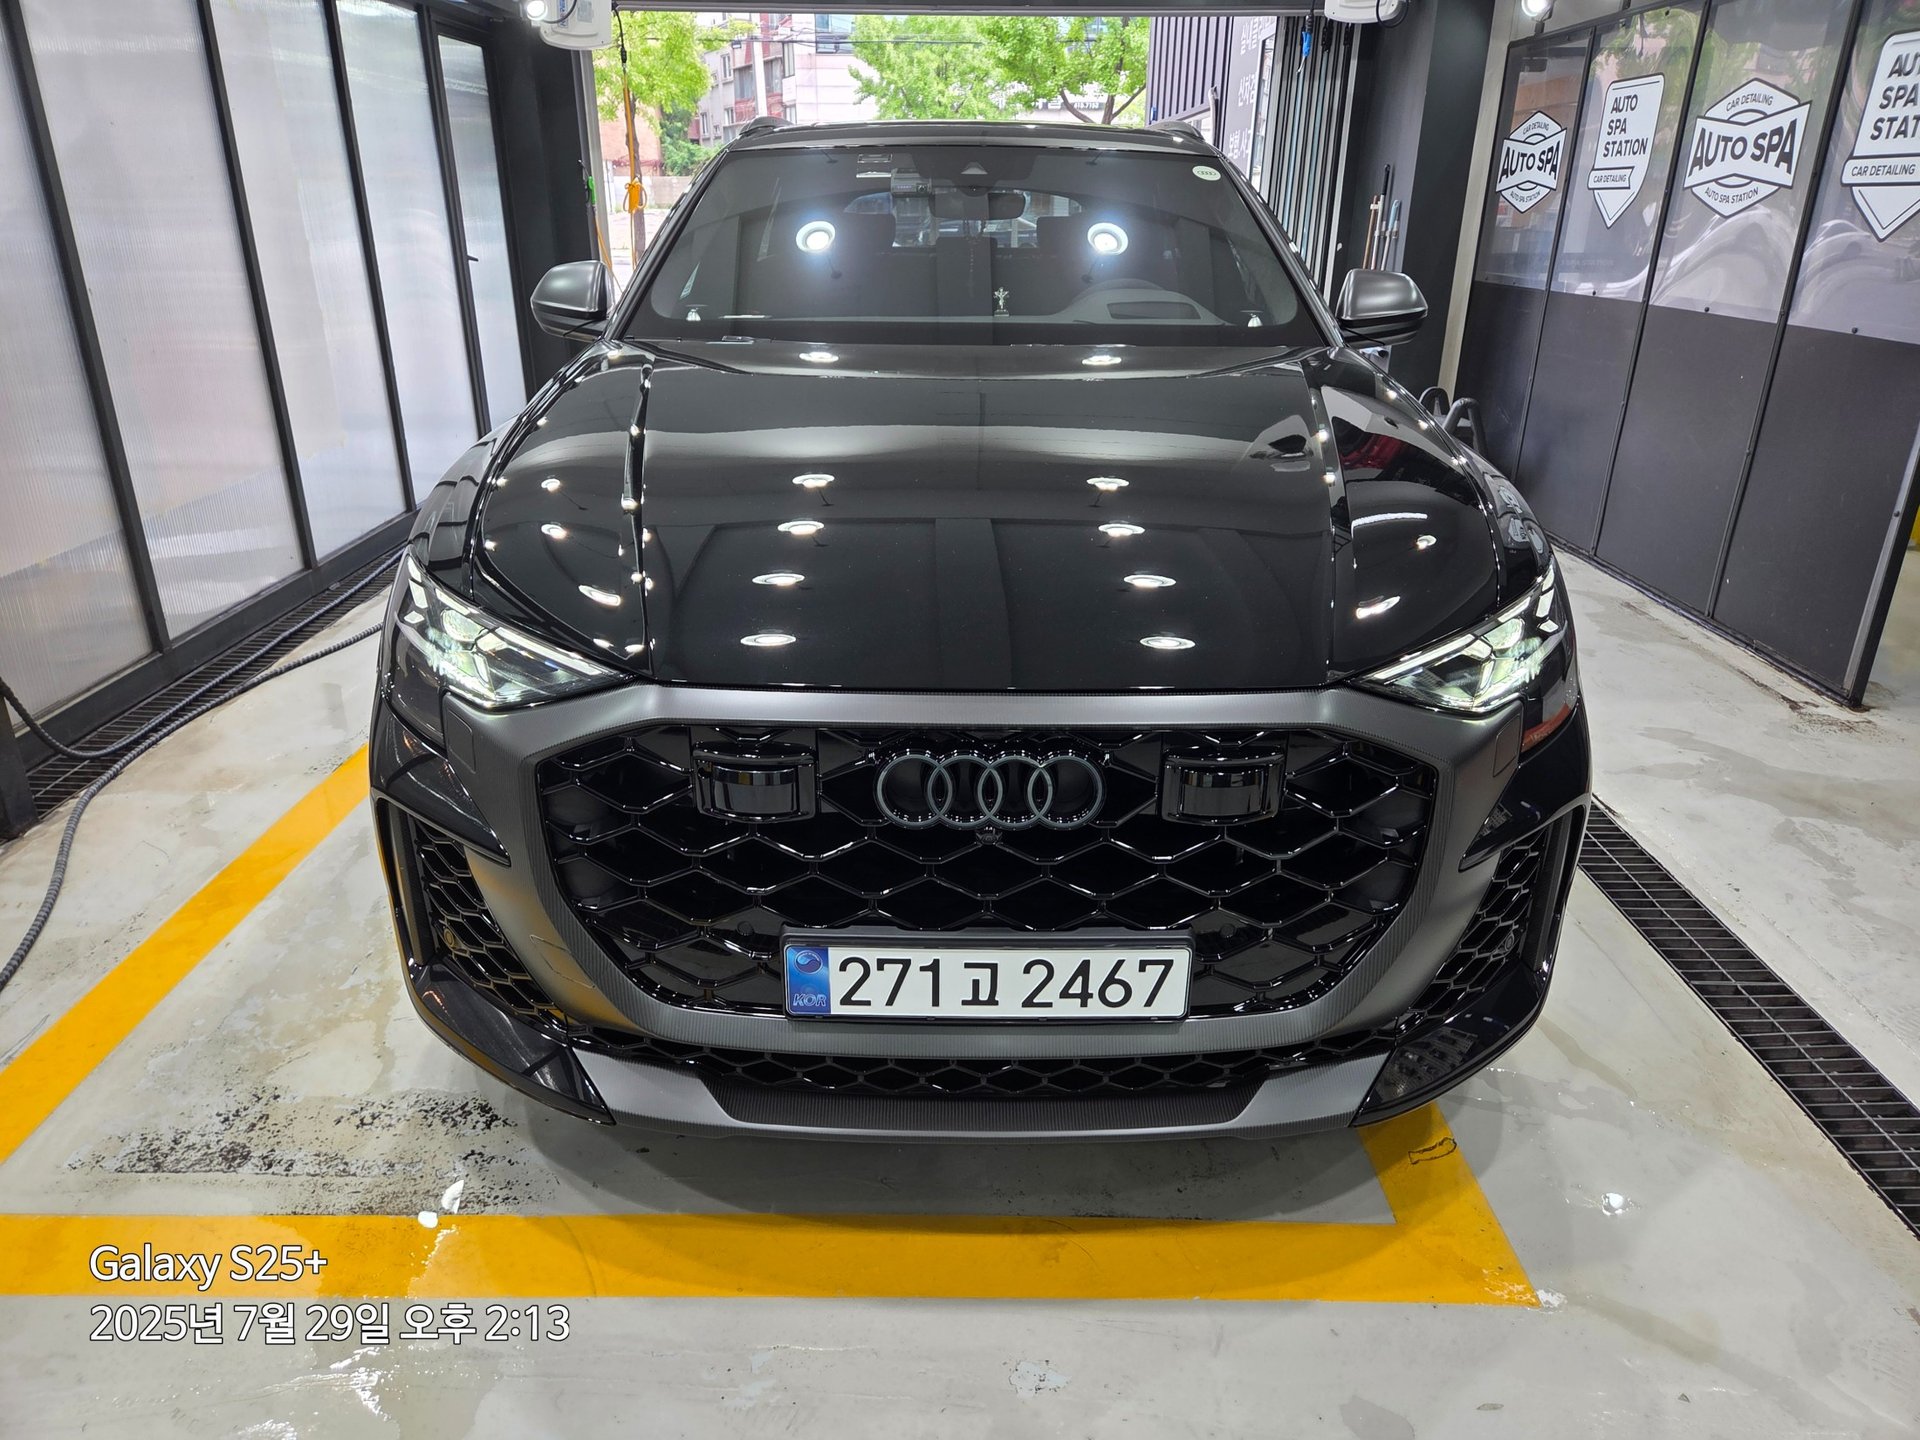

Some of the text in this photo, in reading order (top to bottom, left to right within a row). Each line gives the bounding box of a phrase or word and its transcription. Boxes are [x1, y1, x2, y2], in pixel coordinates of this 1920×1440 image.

[1610, 94, 1638, 114] AUTO
[1726, 93, 1774, 111] CAR DETAILING
[1879, 83, 1919, 109] SPA
[1607, 118, 1627, 136] SPA
[1602, 138, 1648, 158] STATION
[1688, 118, 1797, 178] AUTO SPA
[1499, 140, 1560, 183] AUTO SPA
[1851, 163, 1916, 177] CAR DETAILING
[1593, 174, 1627, 184] CAR DETAILING
[1704, 186, 1759, 204] AUTO SPA STATION
[1021, 958, 1174, 1009] 2467
[793, 993, 827, 1007] KOR
